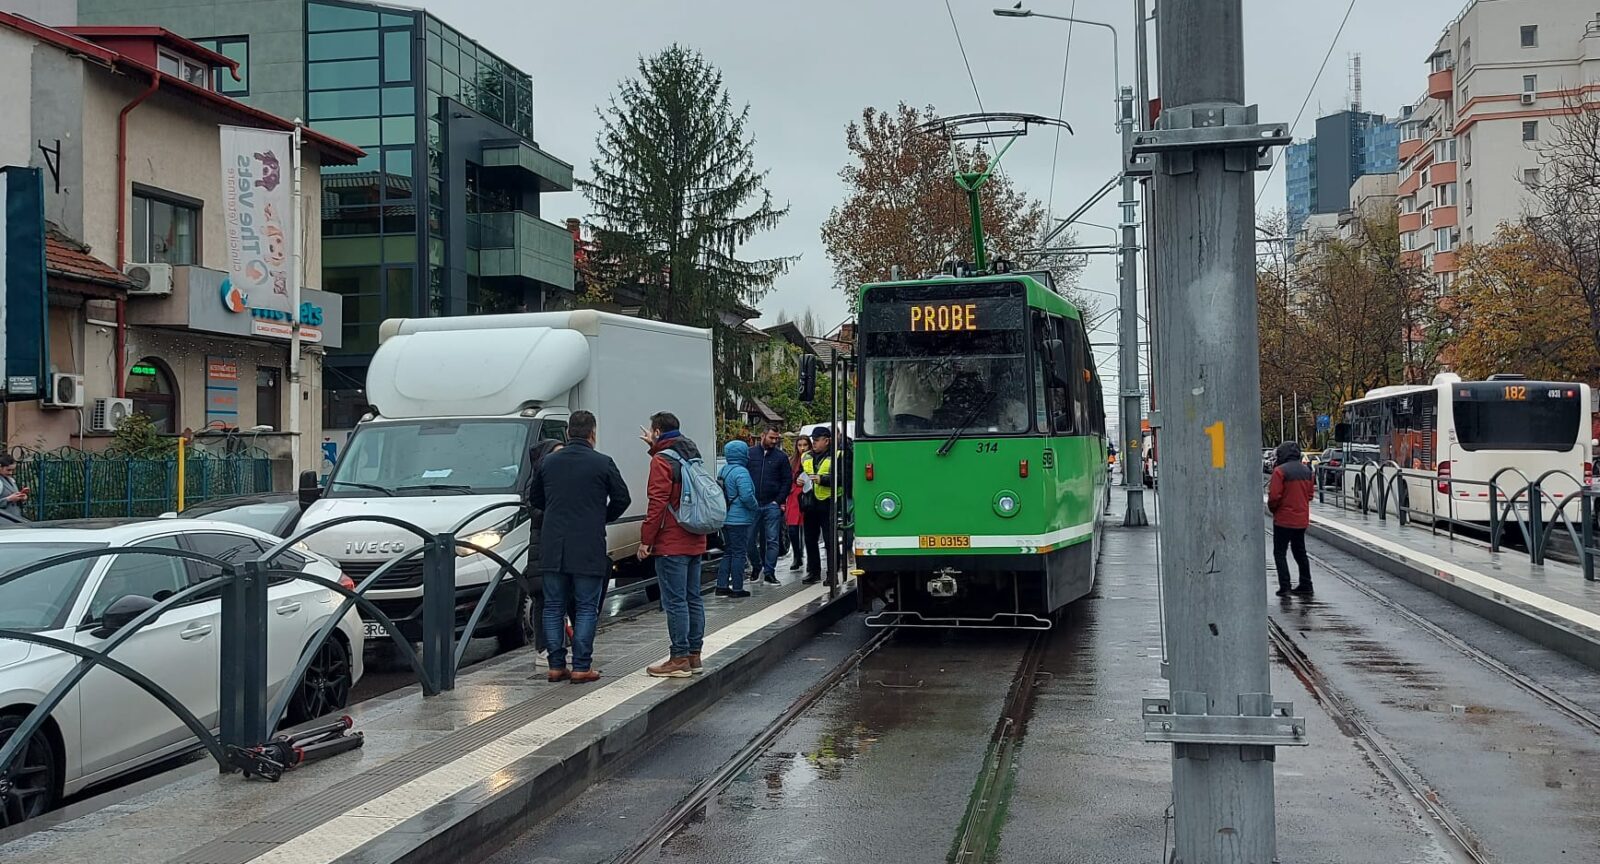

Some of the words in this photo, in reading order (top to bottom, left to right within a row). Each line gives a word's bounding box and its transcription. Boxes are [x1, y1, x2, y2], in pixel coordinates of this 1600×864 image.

[911, 304, 977, 331] PROBE
[1504, 385, 1526, 400] 182
[976, 442, 998, 453] 314
[1130, 439, 1138, 448] 2
[1204, 420, 1226, 469] 1
[345, 541, 405, 554] IVECO
[928, 536, 936, 547] B
[940, 536, 969, 547] 03153
